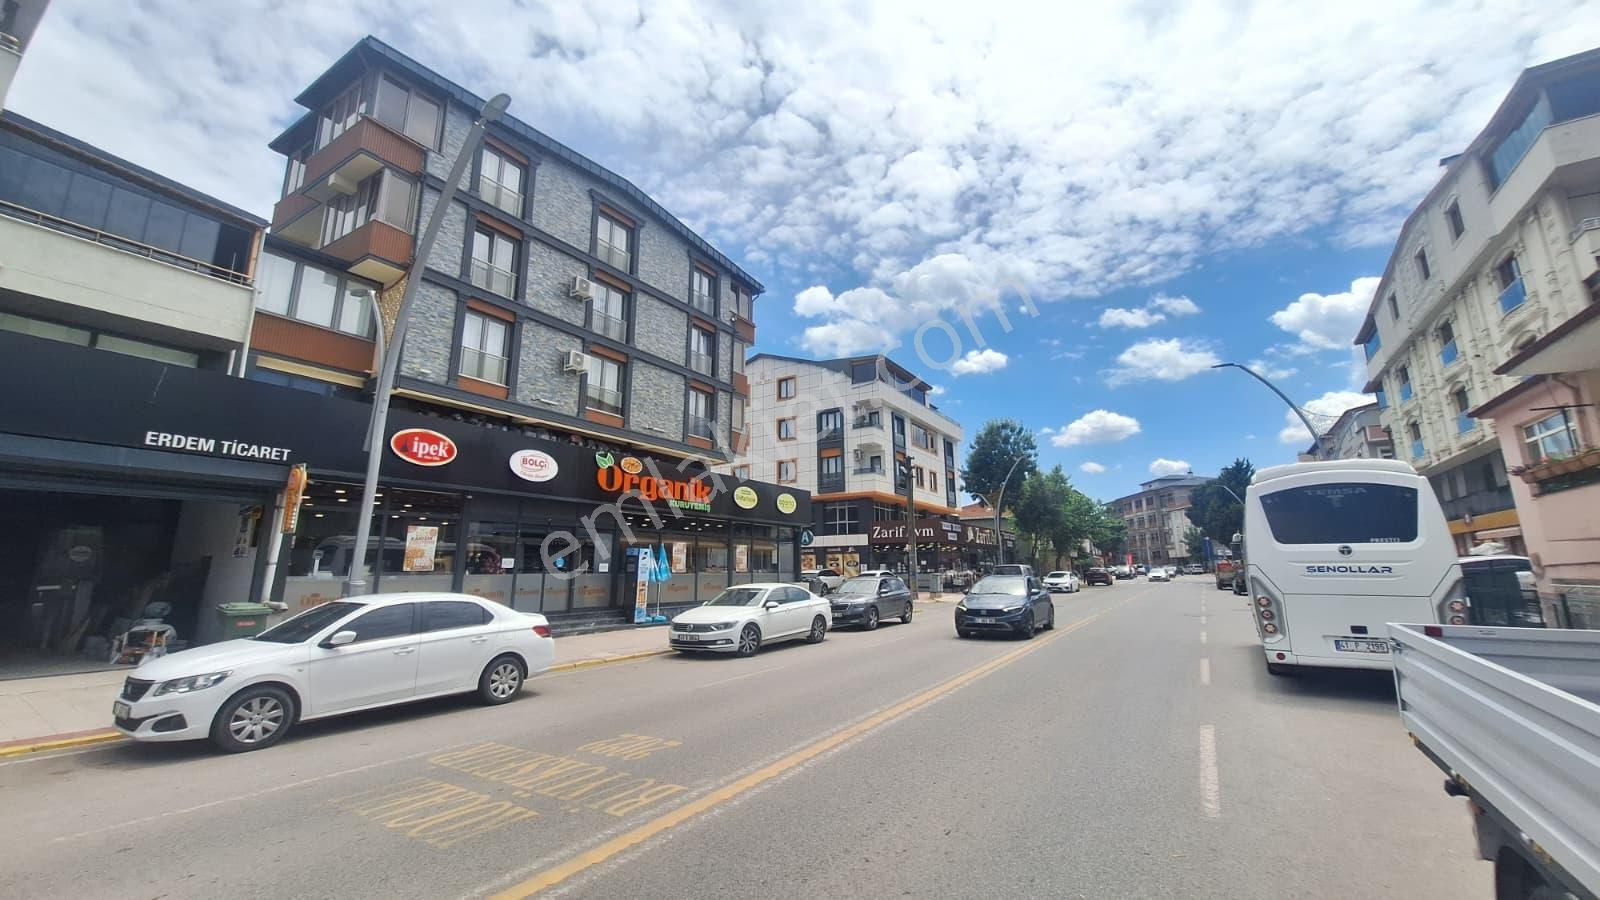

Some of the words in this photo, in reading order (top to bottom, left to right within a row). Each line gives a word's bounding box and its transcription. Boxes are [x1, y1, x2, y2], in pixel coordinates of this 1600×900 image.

[145, 431, 215, 453] ERDEM
[222, 439, 291, 462] TİCARET
[412, 437, 449, 458] ipek
[597, 464, 712, 503] Organik
[1305, 487, 1367, 496] TEMSA
[872, 526, 905, 539] Zarif
[906, 527, 934, 538] vm
